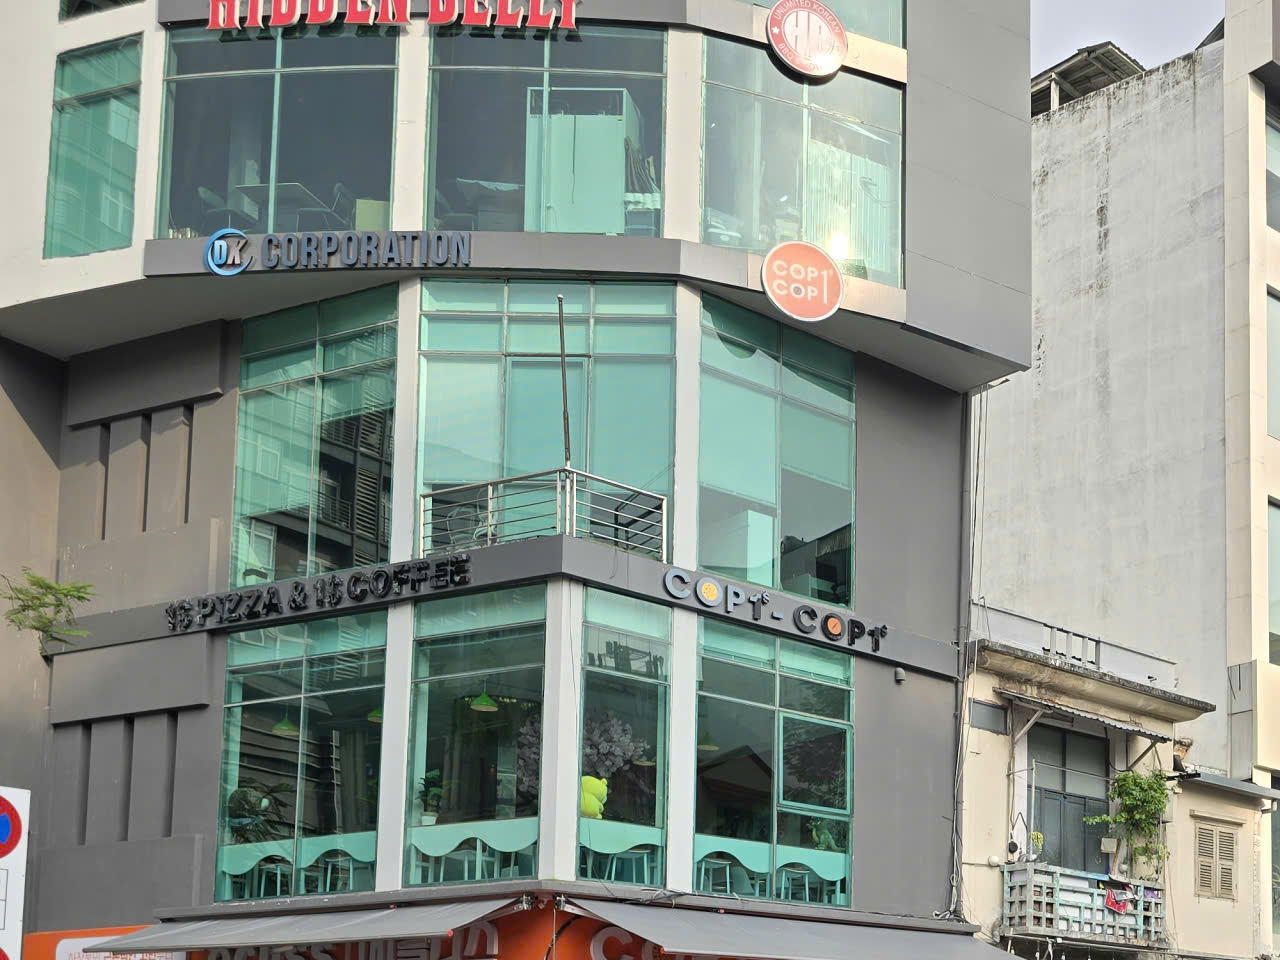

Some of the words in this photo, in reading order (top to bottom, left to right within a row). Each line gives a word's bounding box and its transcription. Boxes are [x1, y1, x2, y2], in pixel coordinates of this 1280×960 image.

[812, 3, 841, 33] KOREAN
[261, 231, 471, 268] CORPORATION
[772, 260, 818, 281] COP
[772, 279, 818, 301] COP
[197, 586, 283, 626] PIZZA
[288, 581, 309, 612] &
[347, 553, 472, 600] COFFEE
